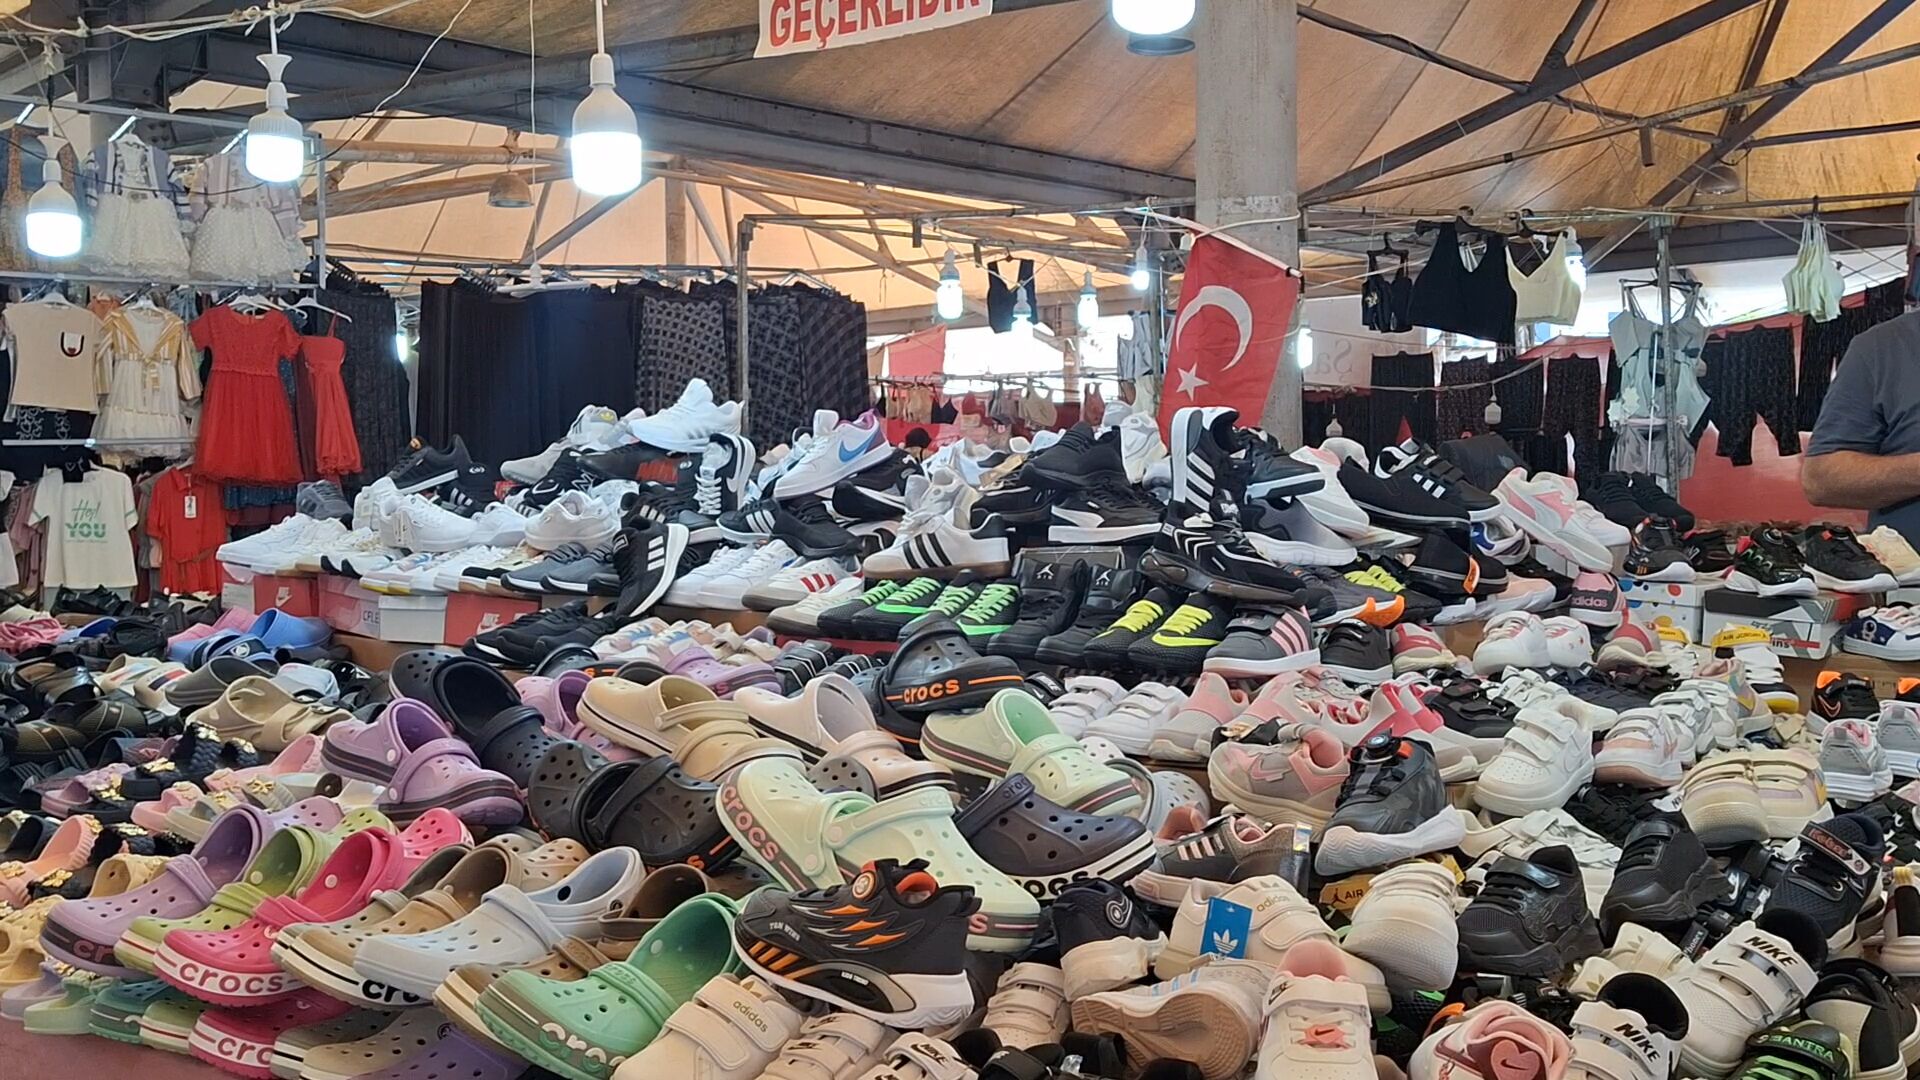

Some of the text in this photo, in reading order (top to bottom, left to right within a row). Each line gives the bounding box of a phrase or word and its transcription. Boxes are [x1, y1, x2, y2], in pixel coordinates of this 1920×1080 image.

[769, 0, 980, 49] GEÇERL
[65, 523, 106, 539] YOU
[902, 679, 959, 703] crocs
[723, 785, 779, 862] crocs
[1014, 871, 1088, 899] ocs
[1344, 888, 1364, 900] AIR
[1744, 936, 1798, 967] NIKE
[179, 961, 284, 996] crocs
[732, 1000, 769, 1034] adidas
[217, 1036, 273, 1067] cro
[920, 1043, 948, 1064] NIKE
[1614, 1023, 1660, 1064] NIKE
